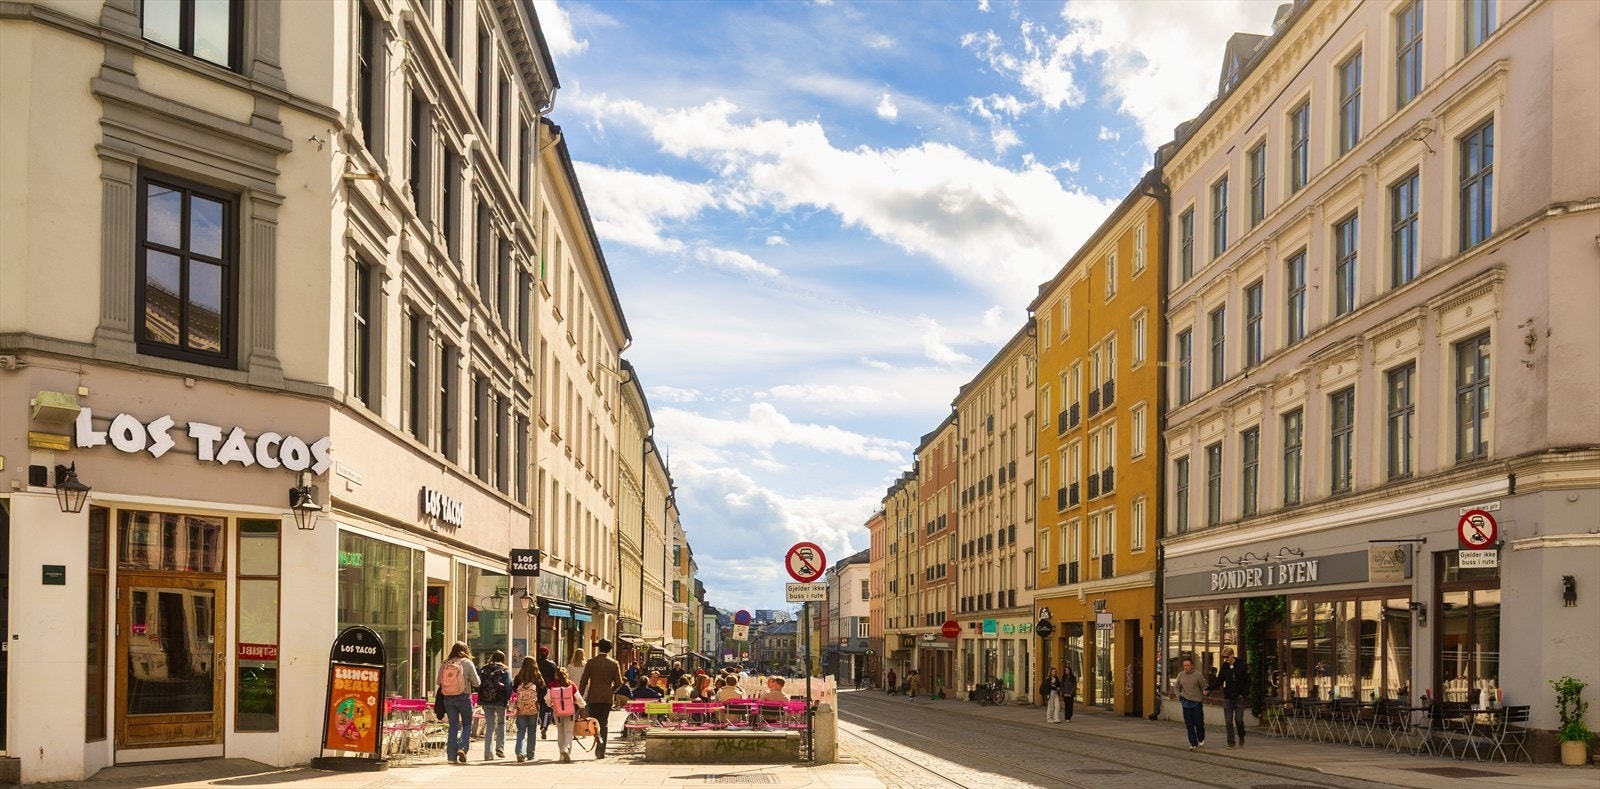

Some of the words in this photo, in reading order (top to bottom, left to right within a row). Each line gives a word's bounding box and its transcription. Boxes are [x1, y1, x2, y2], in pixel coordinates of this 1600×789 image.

[75, 407, 176, 458] LOS
[187, 421, 333, 476] TACOS
[422, 486, 440, 519] LOS
[440, 494, 463, 527] TACOS
[1211, 567, 1262, 591] BØNDER
[1267, 566, 1274, 586] I
[1278, 560, 1318, 584] BYEN
[341, 644, 354, 653] LOS
[355, 646, 376, 655] TACOS
[334, 679, 378, 692] DEALS
[335, 668, 379, 682] LUNCH
